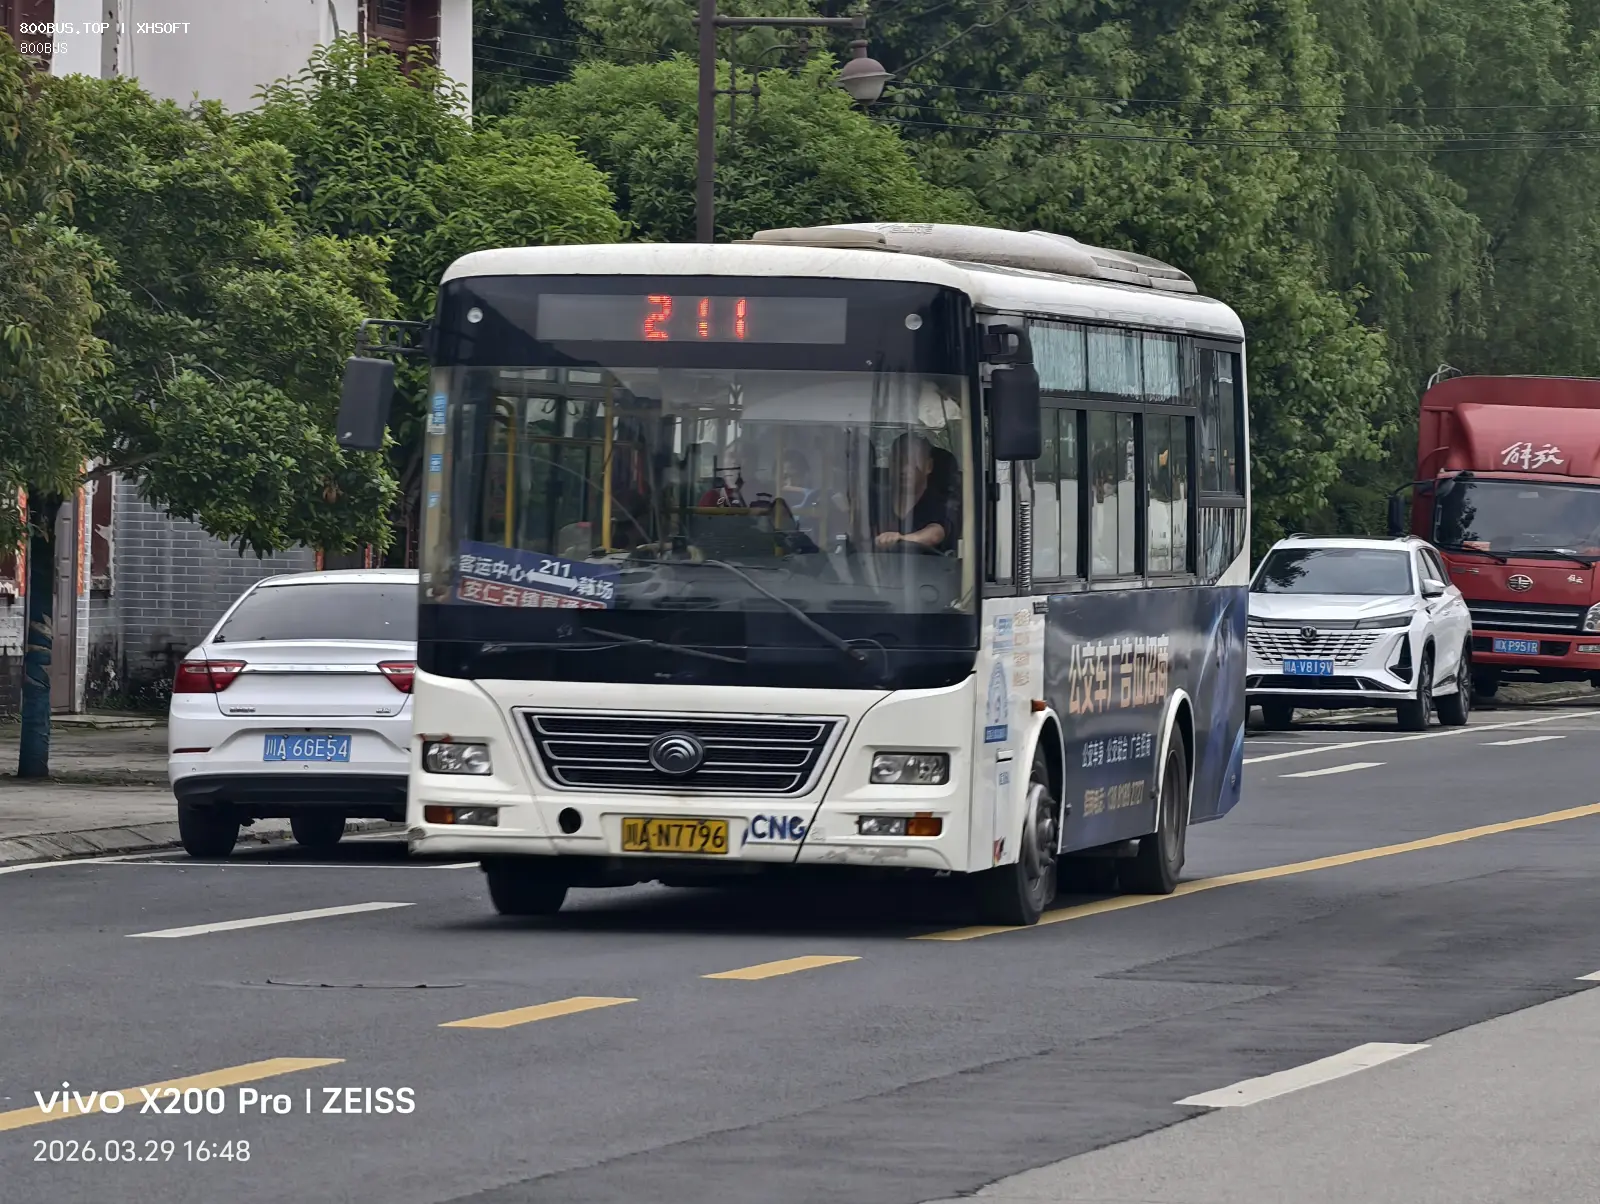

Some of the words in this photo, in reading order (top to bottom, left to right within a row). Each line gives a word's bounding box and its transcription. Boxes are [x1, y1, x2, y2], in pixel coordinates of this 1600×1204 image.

[644, 295, 747, 340] 211
[1500, 441, 1565, 470] 解放
[458, 553, 527, 584] 客运中心
[539, 559, 572, 578] 211
[1067, 633, 1170, 716] 公交车广告位招商
[750, 813, 808, 842] CNG
